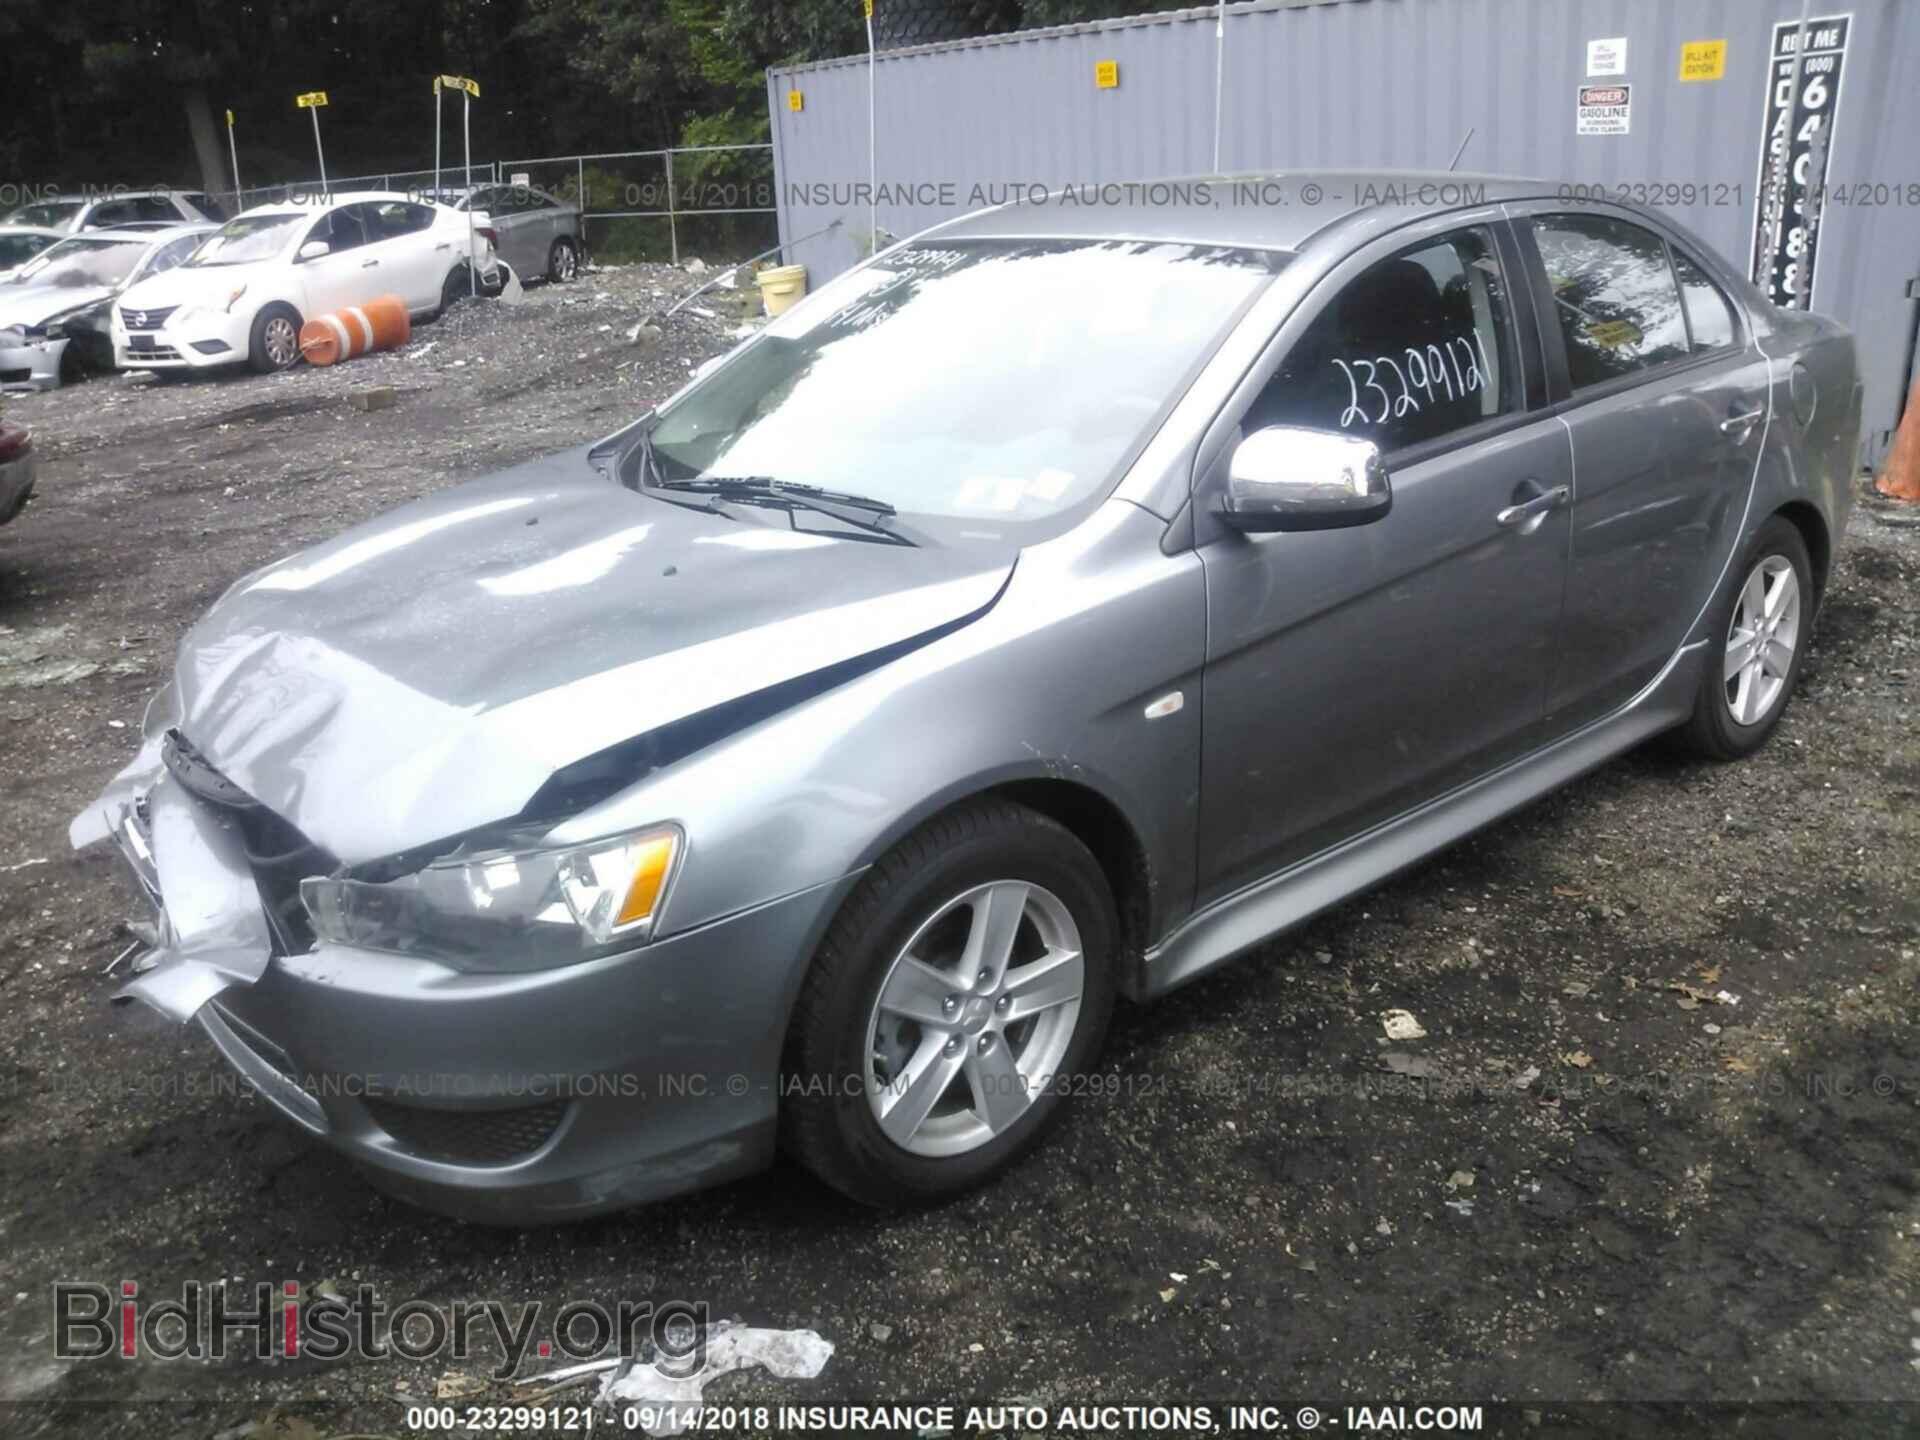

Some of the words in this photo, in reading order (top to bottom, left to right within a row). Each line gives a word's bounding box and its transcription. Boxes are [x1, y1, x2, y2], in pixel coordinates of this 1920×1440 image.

[1781, 31, 1812, 53] RET
[1813, 28, 1839, 48] ME
[1580, 107, 1628, 118] GASOLINE
[1331, 327, 1493, 428] 23299121
